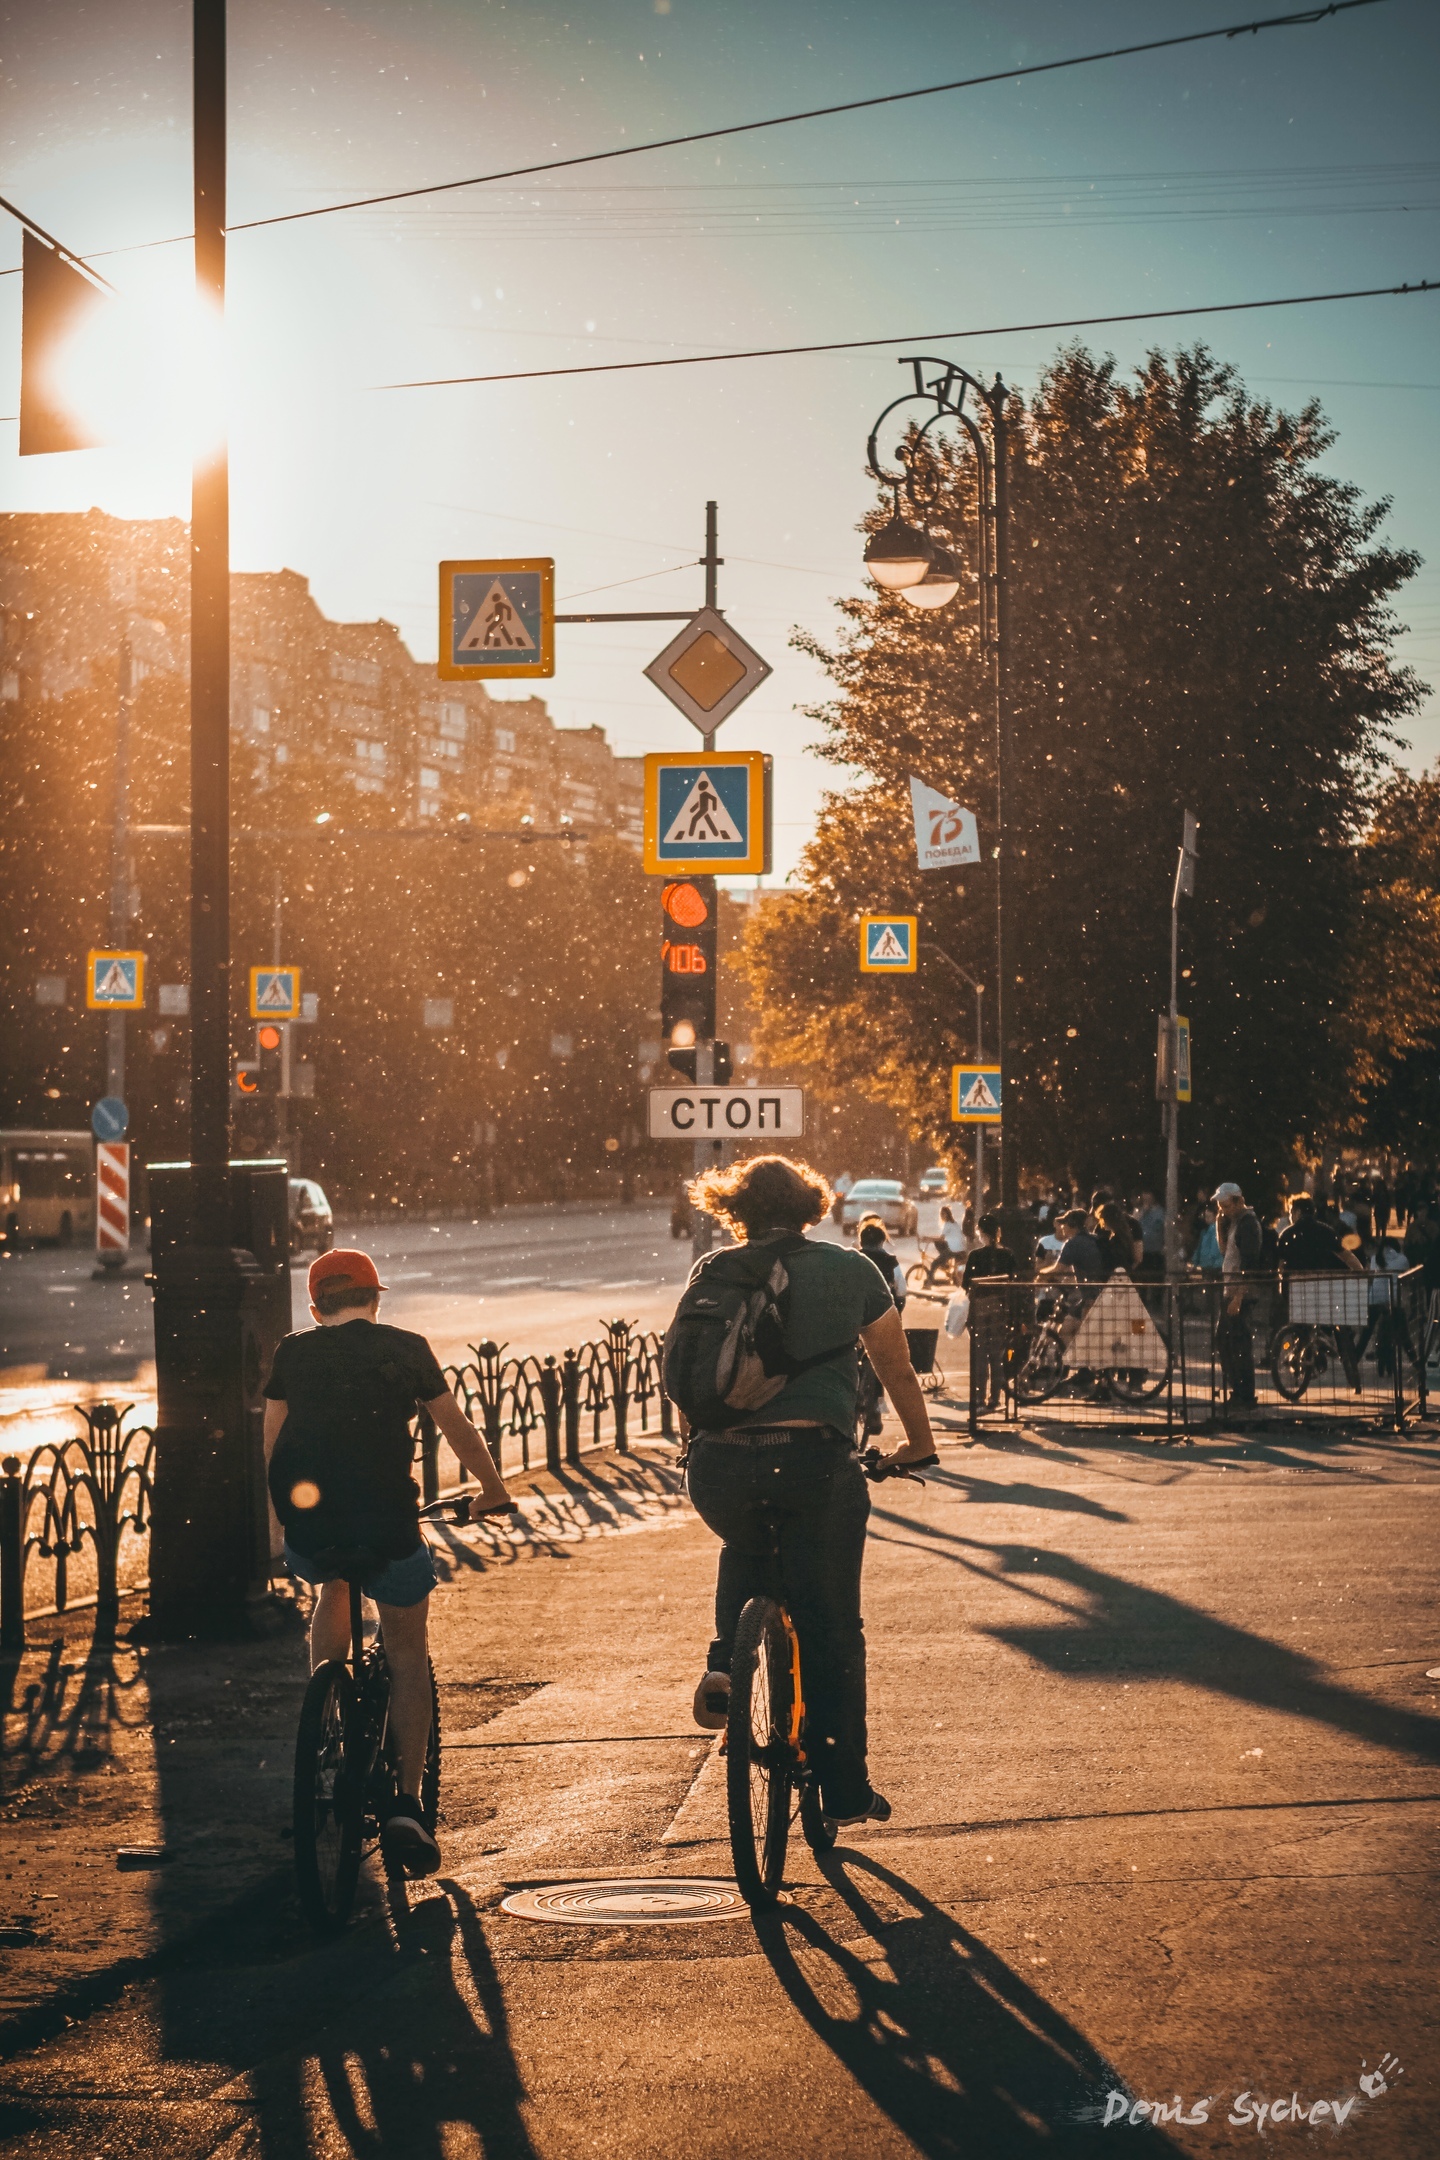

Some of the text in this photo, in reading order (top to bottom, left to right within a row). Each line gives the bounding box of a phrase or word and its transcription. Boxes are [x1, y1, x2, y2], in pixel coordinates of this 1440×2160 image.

[929, 807, 963, 846] 75
[925, 845, 972, 859] ПОБЕДА!
[671, 1098, 781, 1130] СТОП
